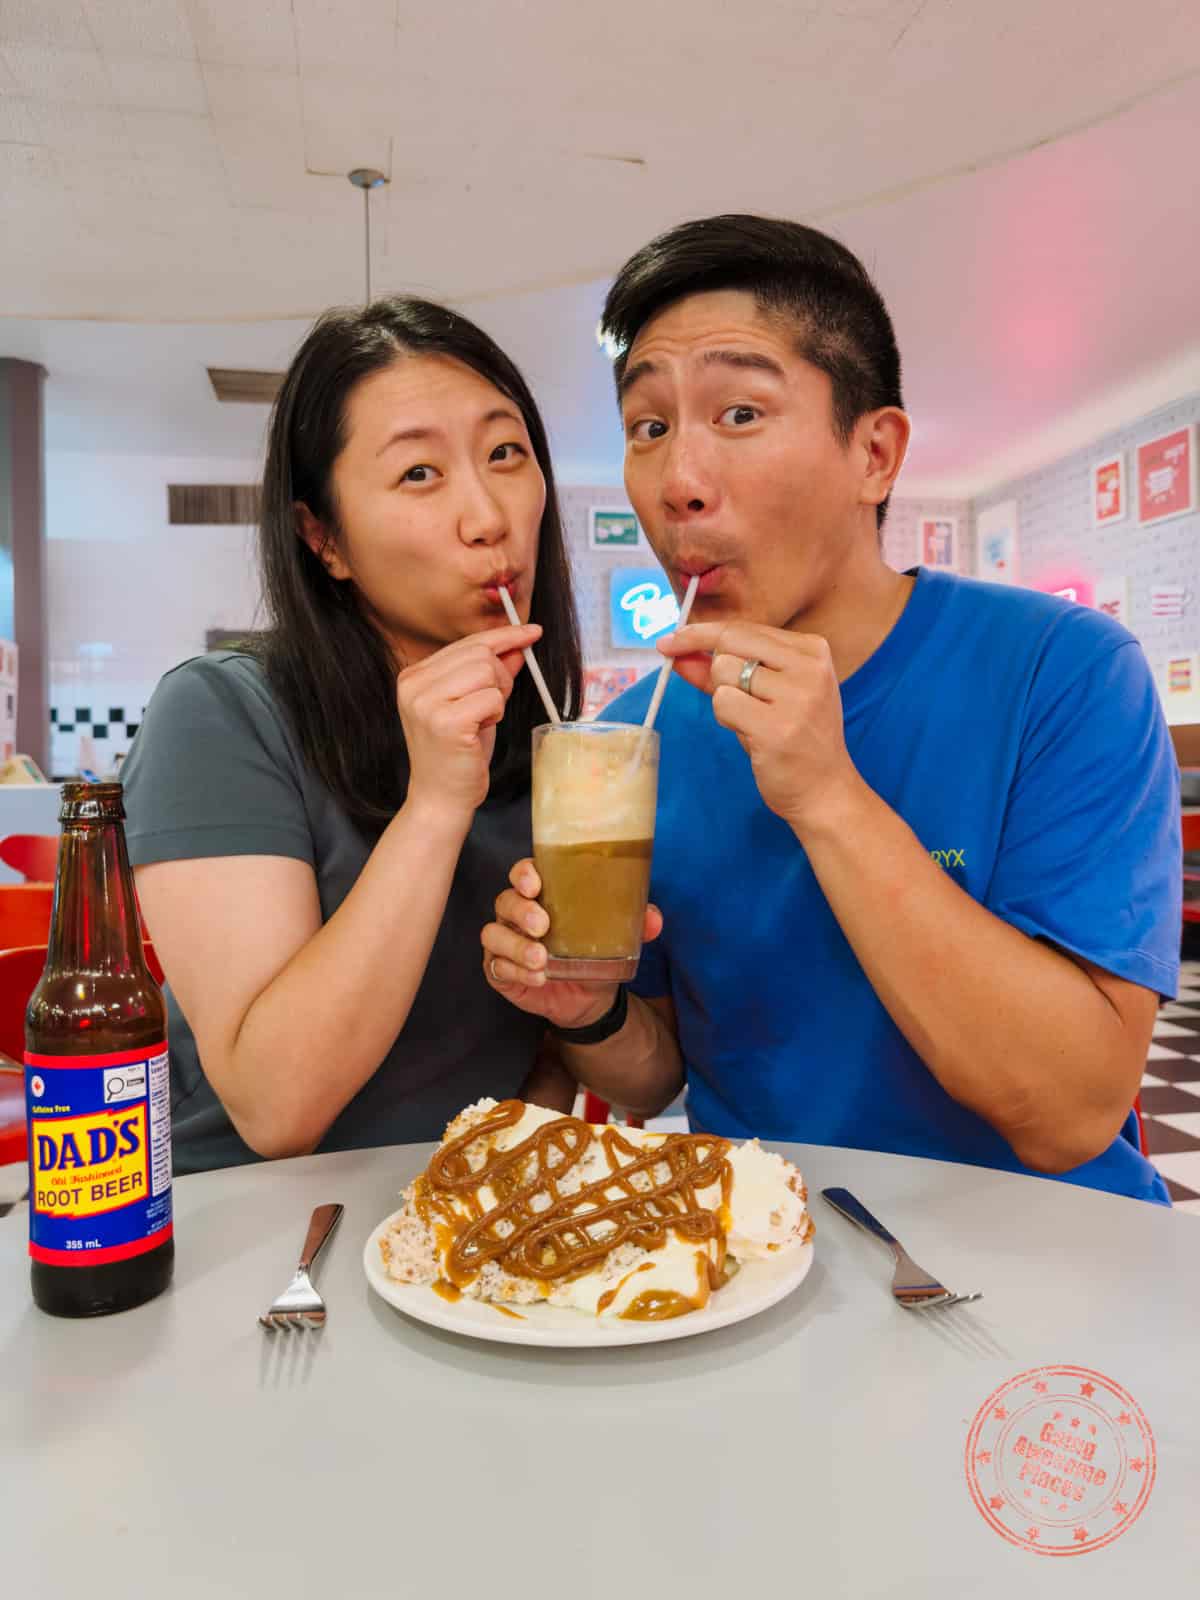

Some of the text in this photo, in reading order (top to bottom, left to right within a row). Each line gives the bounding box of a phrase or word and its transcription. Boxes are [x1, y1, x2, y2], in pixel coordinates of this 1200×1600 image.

[37, 1116, 140, 1172] DAD'S
[38, 1171, 143, 1207] ROOT BEER
[65, 1238, 102, 1249] 355 mL
